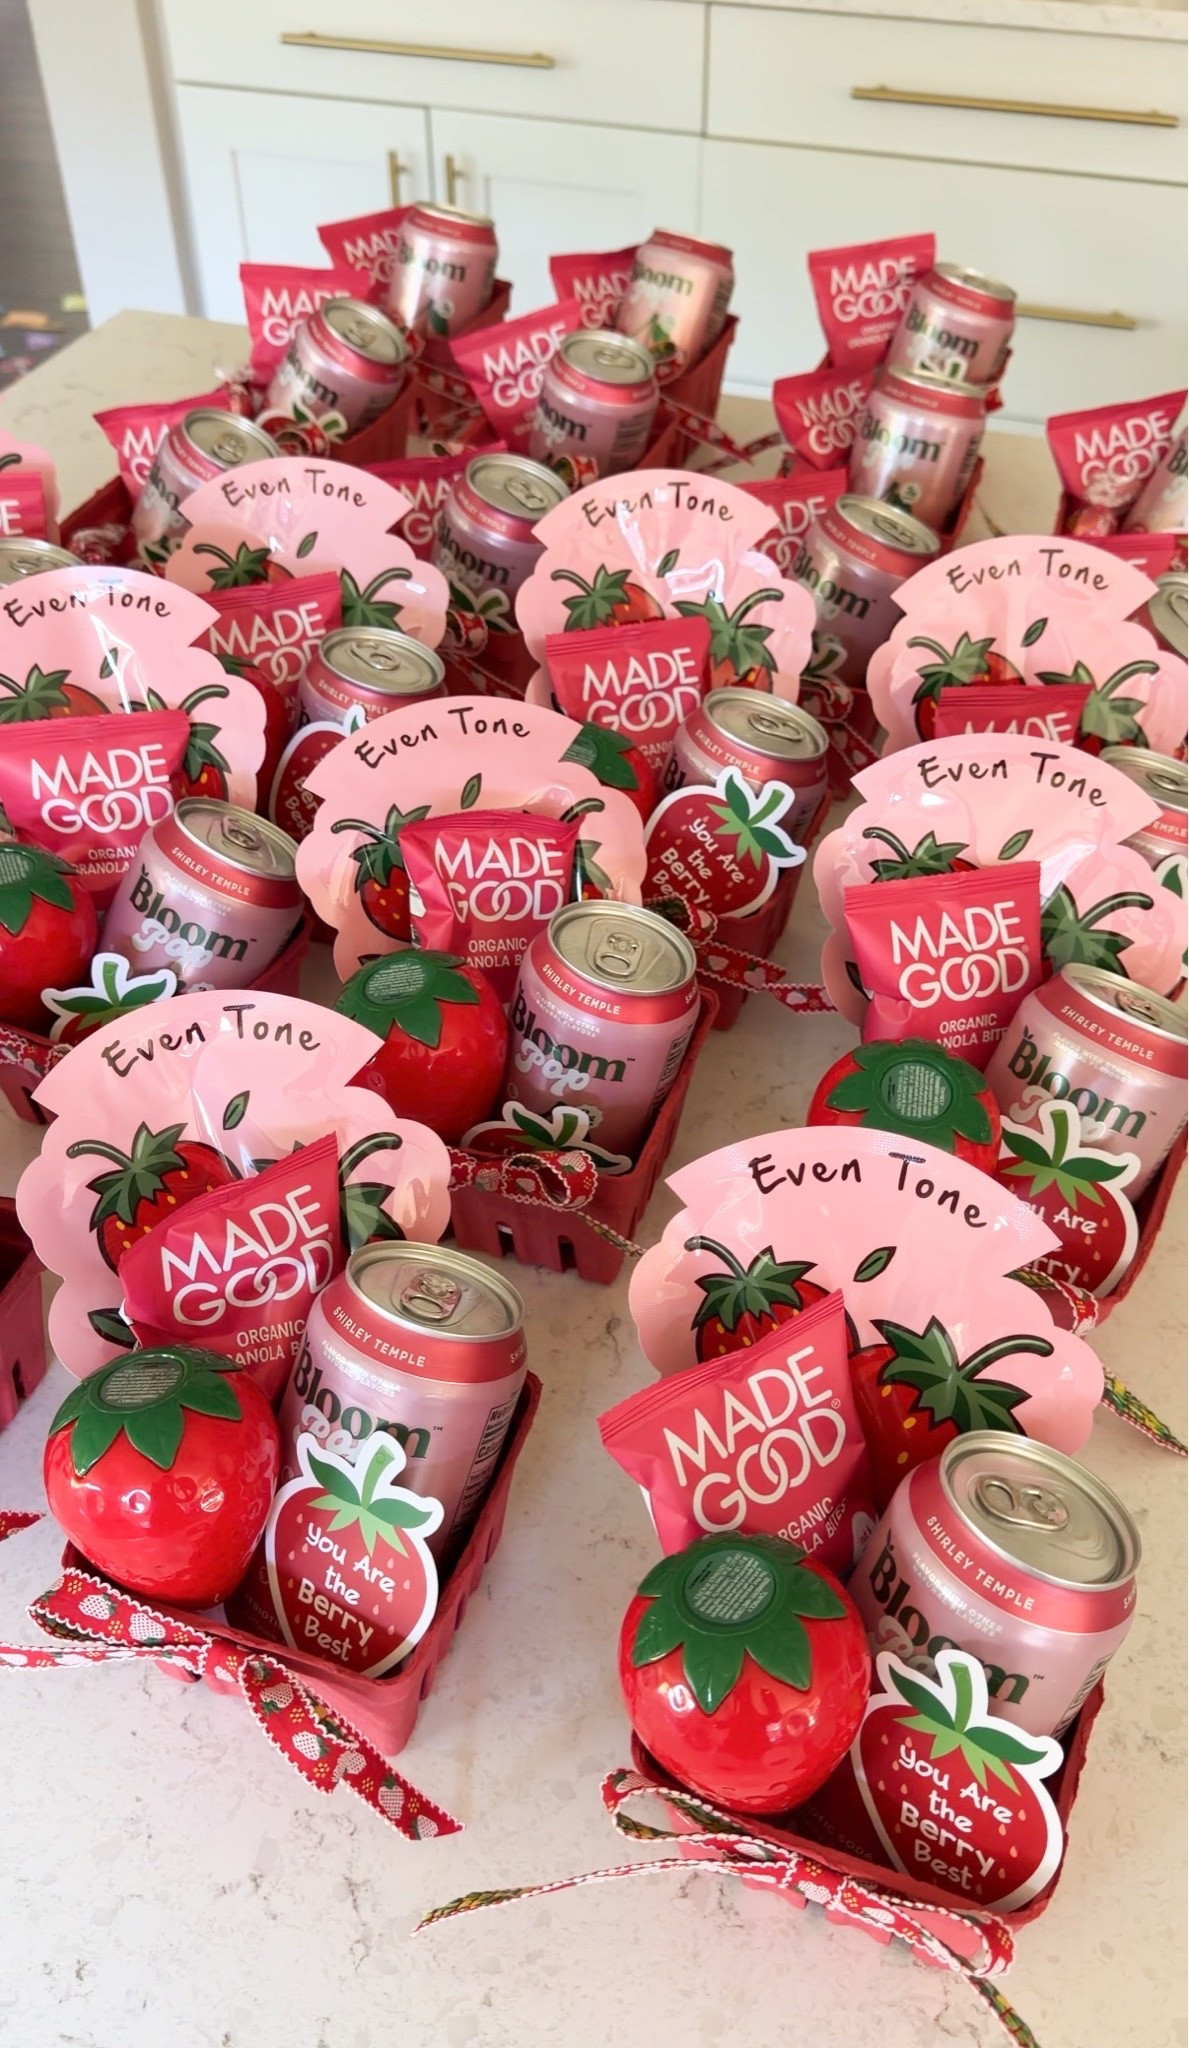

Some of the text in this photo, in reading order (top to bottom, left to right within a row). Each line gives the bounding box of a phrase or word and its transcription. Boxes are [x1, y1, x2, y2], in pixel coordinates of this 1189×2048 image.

[1074, 410, 1170, 463] MADE
[222, 469, 368, 508] Even Tone
[581, 481, 734, 528] Even Tone
[946, 548, 1109, 594] Even Tone
[210, 601, 327, 655] MADE
[583, 647, 699, 702] MADE
[353, 706, 532, 770] Even Tone
[724, 751, 761, 775] TEMPLE
[31, 743, 170, 801] MADE
[917, 752, 1109, 808] Even Tone
[41, 784, 175, 835] GOOD
[171, 846, 208, 878] SHIRLEY
[211, 872, 252, 897] TEMPLE
[435, 836, 566, 882] MADE
[660, 846, 711, 905] Berry
[687, 848, 713, 880] the
[716, 853, 745, 884] Are
[448, 878, 565, 924] GOOD
[468, 937, 528, 954] ORGANIC
[889, 900, 1026, 966] MADE
[542, 963, 622, 1016] SHIRLEY TEMPLE
[900, 947, 1030, 1010] GOOD
[101, 1003, 321, 1078] Even Tone
[939, 1013, 998, 1034] ORGANIC
[1060, 1005, 1156, 1061] SHIRLEY TEMPLE
[748, 1151, 988, 1229] Even Tone
[161, 1184, 330, 1294] MADE
[1052, 1206, 1098, 1235] Are
[172, 1239, 335, 1328] GOOD
[236, 1319, 307, 1348] ORGANIC
[332, 1305, 428, 1368] SHIRLEY TEMPLE
[663, 1345, 833, 1488] MADE
[692, 1407, 847, 1534] GOOD
[777, 1496, 834, 1542] RGANIC
[324, 1564, 361, 1606] the
[352, 1554, 396, 1594] Are
[926, 1515, 975, 1570] SHIRLEY
[975, 1567, 1036, 1612] TEMPLE
[297, 1577, 375, 1648] Berry
[303, 1614, 353, 1662] Best
[928, 1787, 974, 1834] the
[959, 1782, 1014, 1826] Are
[900, 1801, 997, 1879] Berry
[912, 1839, 974, 1893] Best
